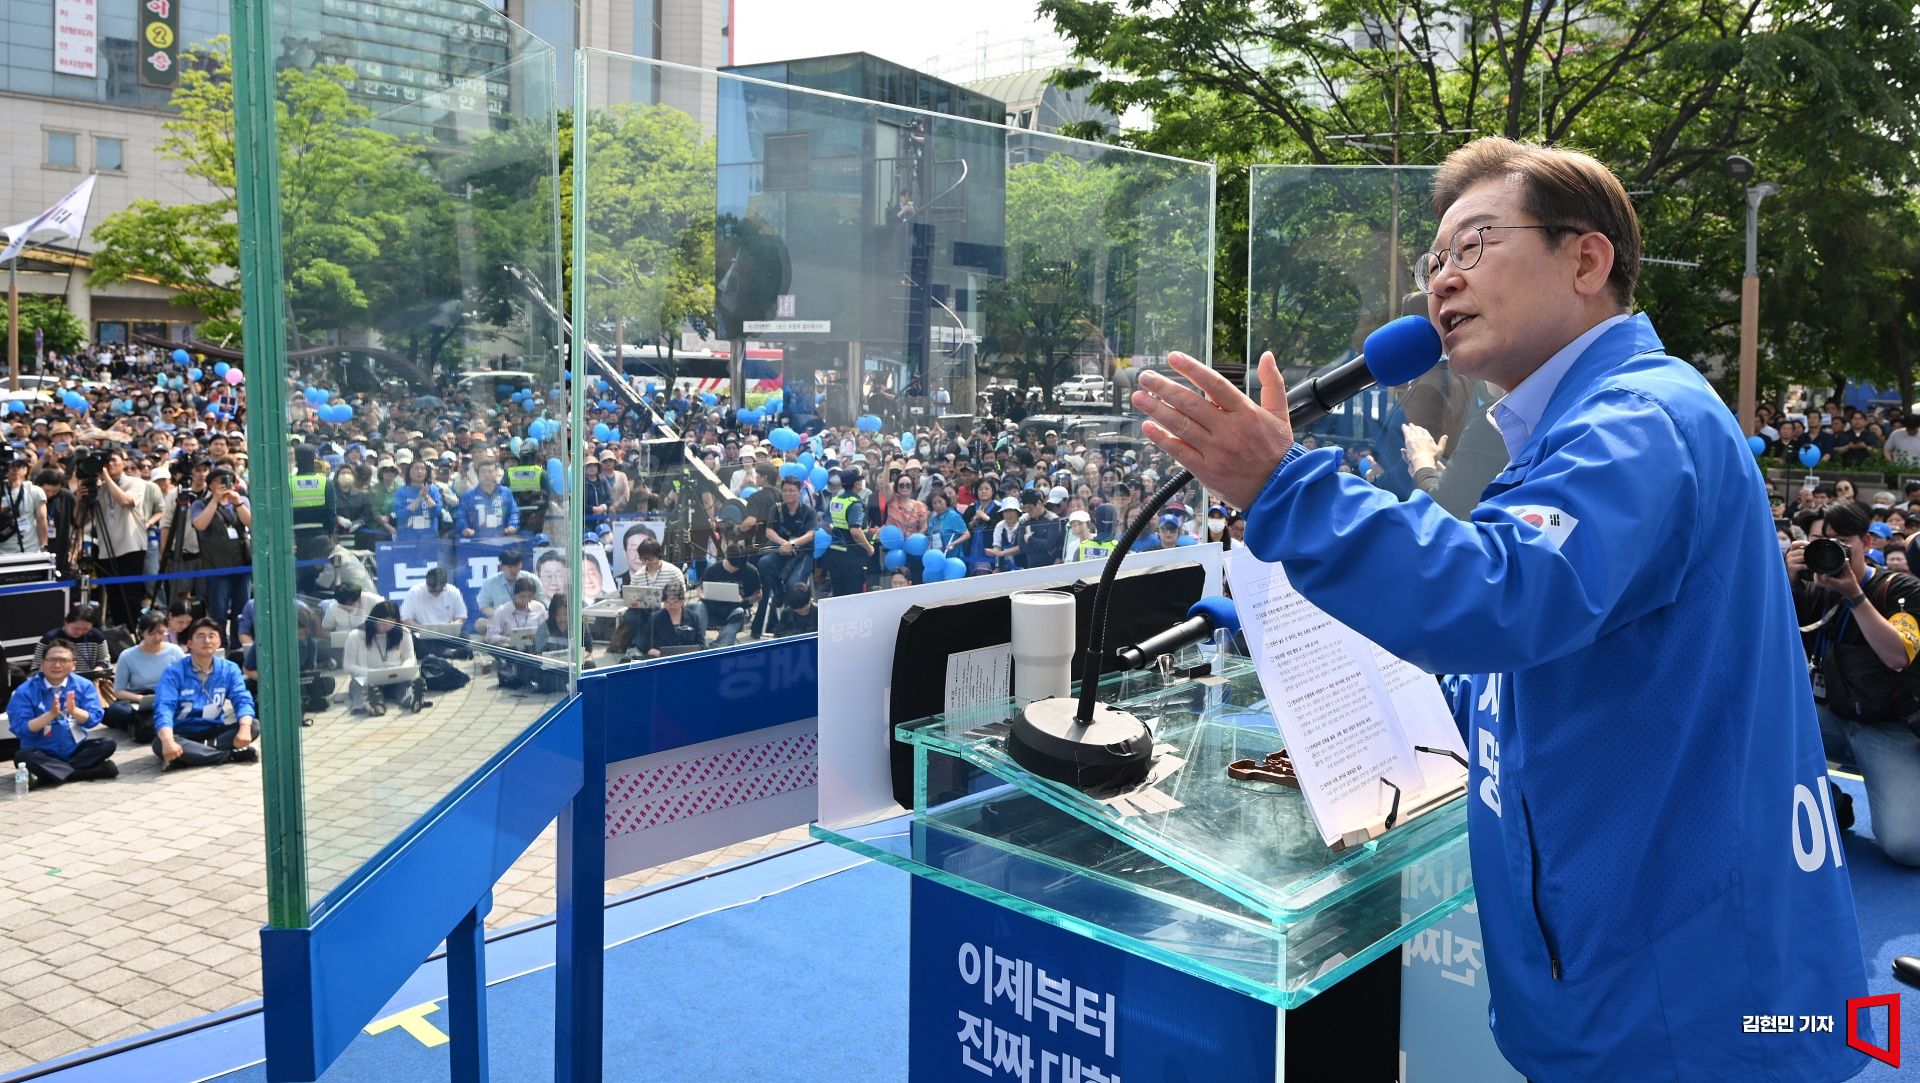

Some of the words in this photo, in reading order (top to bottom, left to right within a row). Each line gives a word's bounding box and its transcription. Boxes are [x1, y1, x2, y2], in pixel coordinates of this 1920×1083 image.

[152, 26, 168, 45] 2
[958, 942, 1115, 1058] 이제부터
[957, 1009, 1035, 1083] 진짜
